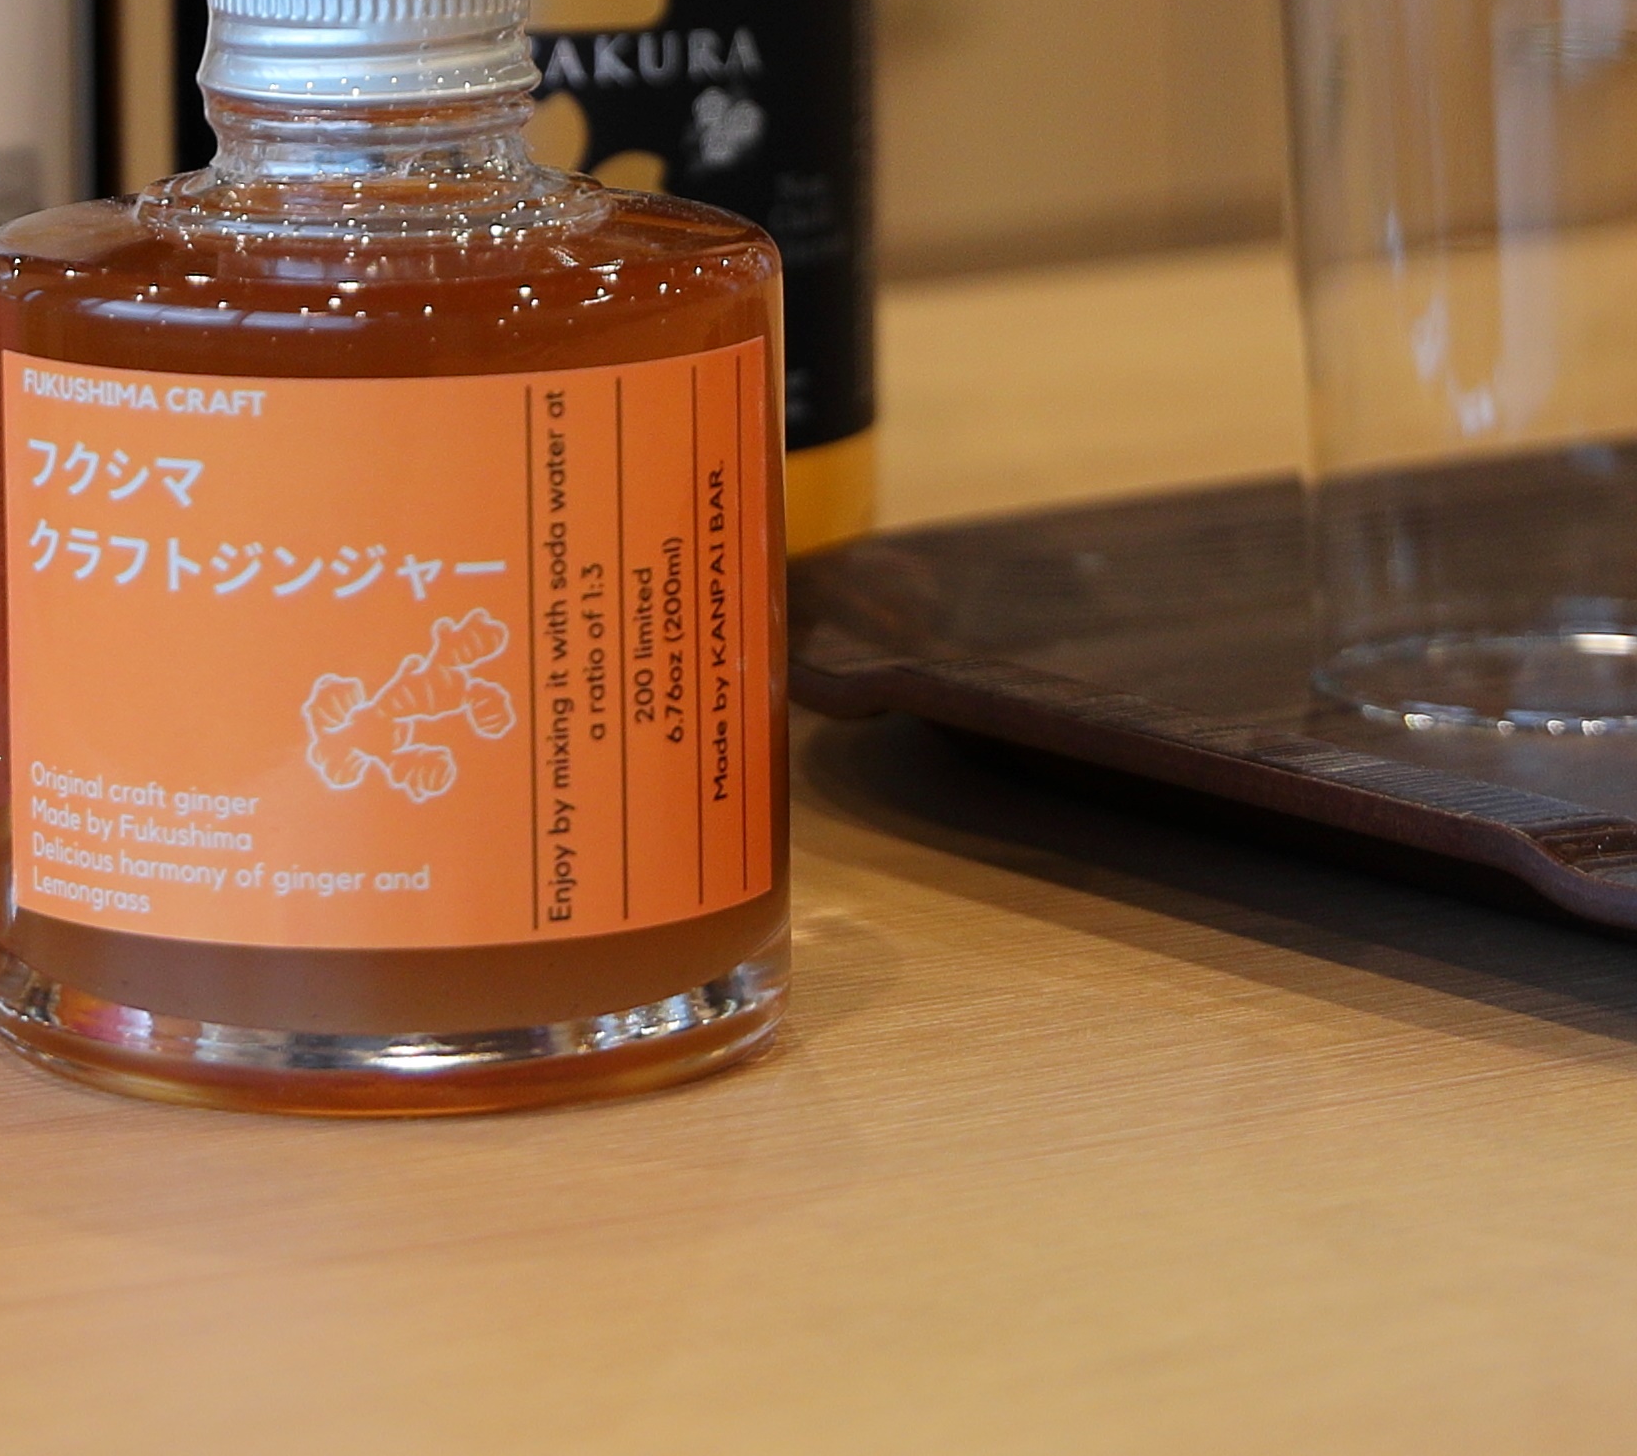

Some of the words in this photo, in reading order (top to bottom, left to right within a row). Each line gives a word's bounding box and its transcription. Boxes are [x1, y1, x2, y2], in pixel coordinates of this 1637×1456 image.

[531, 24, 764, 88] AKURA
[23, 368, 158, 411] FUKUSHIMA
[165, 386, 266, 416] CRAFT
[546, 390, 565, 418] at
[28, 438, 203, 507] フクシマ
[547, 428, 566, 512] water
[709, 460, 724, 532] BAR.
[29, 519, 505, 600] クラフトジンジャー
[544, 522, 567, 589] soda
[581, 563, 604, 599] 1:3
[633, 567, 652, 659] limited
[662, 537, 683, 642] (200ml)
[710, 543, 726, 665] KANPAI
[545, 600, 568, 662] with
[582, 611, 604, 638] of
[547, 670, 568, 687] it
[583, 648, 606, 712] ratio
[635, 669, 654, 723] 200
[665, 651, 683, 742] 6.76oz
[713, 677, 729, 711] by
[547, 697, 574, 788] mixing
[590, 723, 606, 739] a
[713, 720, 727, 801] Made
[31, 761, 103, 798] Original
[109, 782, 166, 808] craft
[174, 786, 259, 820] ginger
[548, 799, 575, 835] by
[31, 796, 81, 831] Made
[87, 808, 113, 840] by
[120, 814, 253, 851] Fukushima
[32, 832, 114, 873] Delicious
[120, 850, 226, 890] harmony
[236, 862, 264, 887] of
[273, 864, 365, 897] ginger
[374, 865, 431, 891] and
[33, 866, 151, 913] Lemongrass
[548, 845, 576, 921] Enjoy
